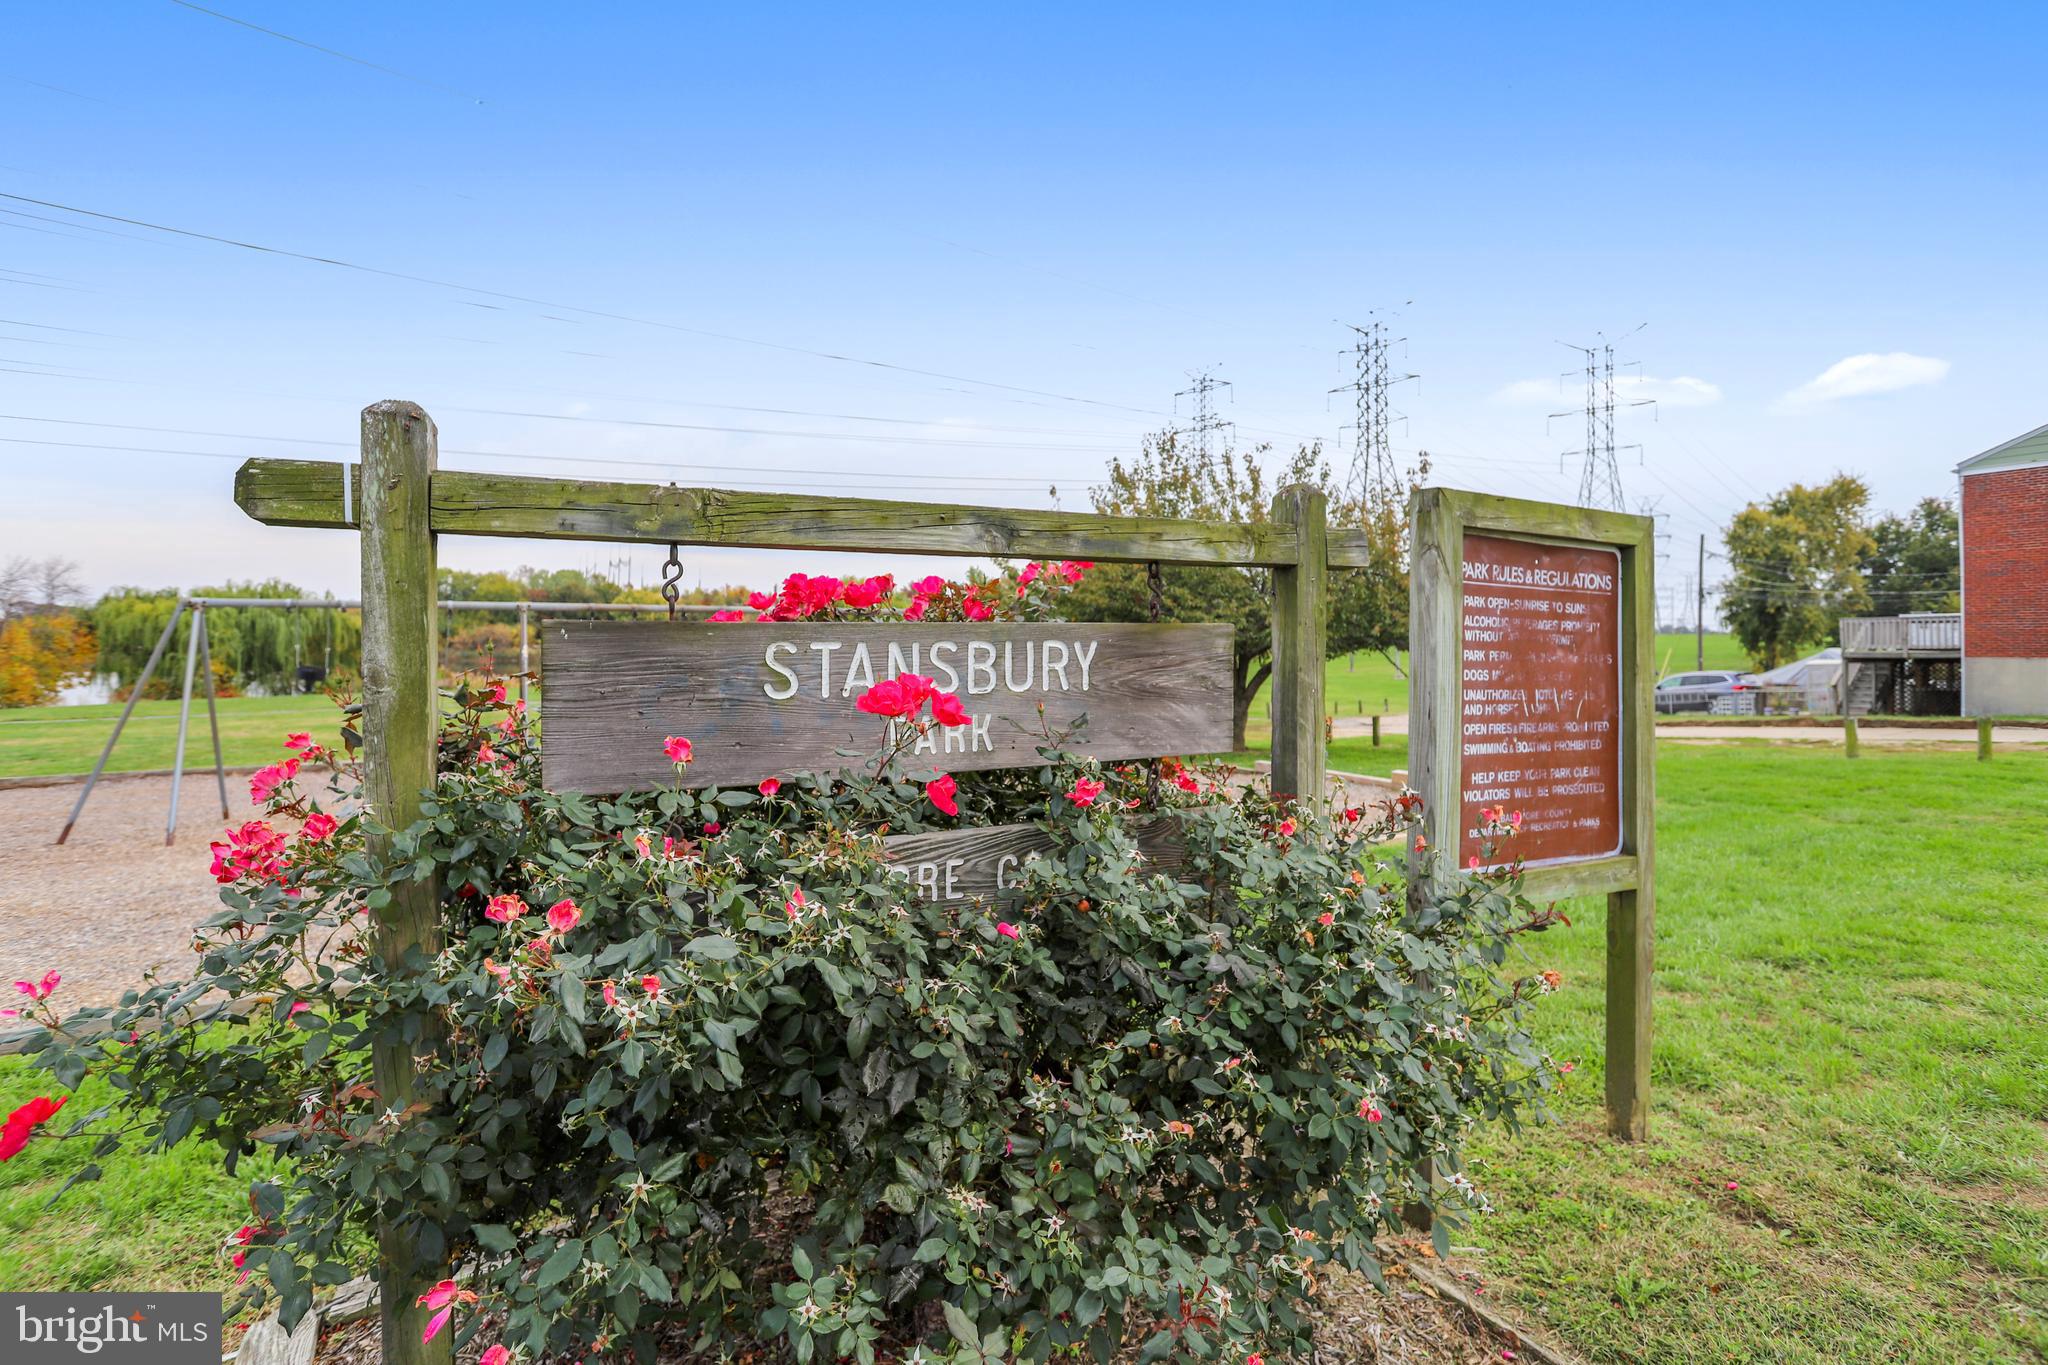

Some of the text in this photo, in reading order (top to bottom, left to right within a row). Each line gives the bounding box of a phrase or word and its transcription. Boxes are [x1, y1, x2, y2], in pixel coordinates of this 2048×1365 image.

[1462, 561, 1489, 580] PARK
[1534, 568, 1612, 591] REGULATIONS
[1464, 595, 1486, 608] PARK
[1465, 630, 1504, 643] WITHOUT
[1464, 650, 1486, 662] PARK
[763, 639, 1098, 700] STANSBURY
[1464, 669, 1489, 681] DOGS
[1464, 703, 1483, 716] AND
[888, 713, 993, 758] PARK
[1464, 723, 1487, 736] OPEN
[1488, 722, 1512, 735] FIRES
[1464, 742, 1508, 756] SWIMMING
[1516, 741, 1551, 753] BOATING
[1554, 739, 1602, 751] PROHIBITED
[1472, 772, 1495, 785] HELP
[1498, 771, 1520, 783] KEEP
[1550, 767, 1571, 780] PARK
[1573, 766, 1600, 778] CLEAN
[1464, 783, 1605, 802] VIOLATORS WILL BE PROSECUTED
[1579, 816, 1600, 830] PARKS
